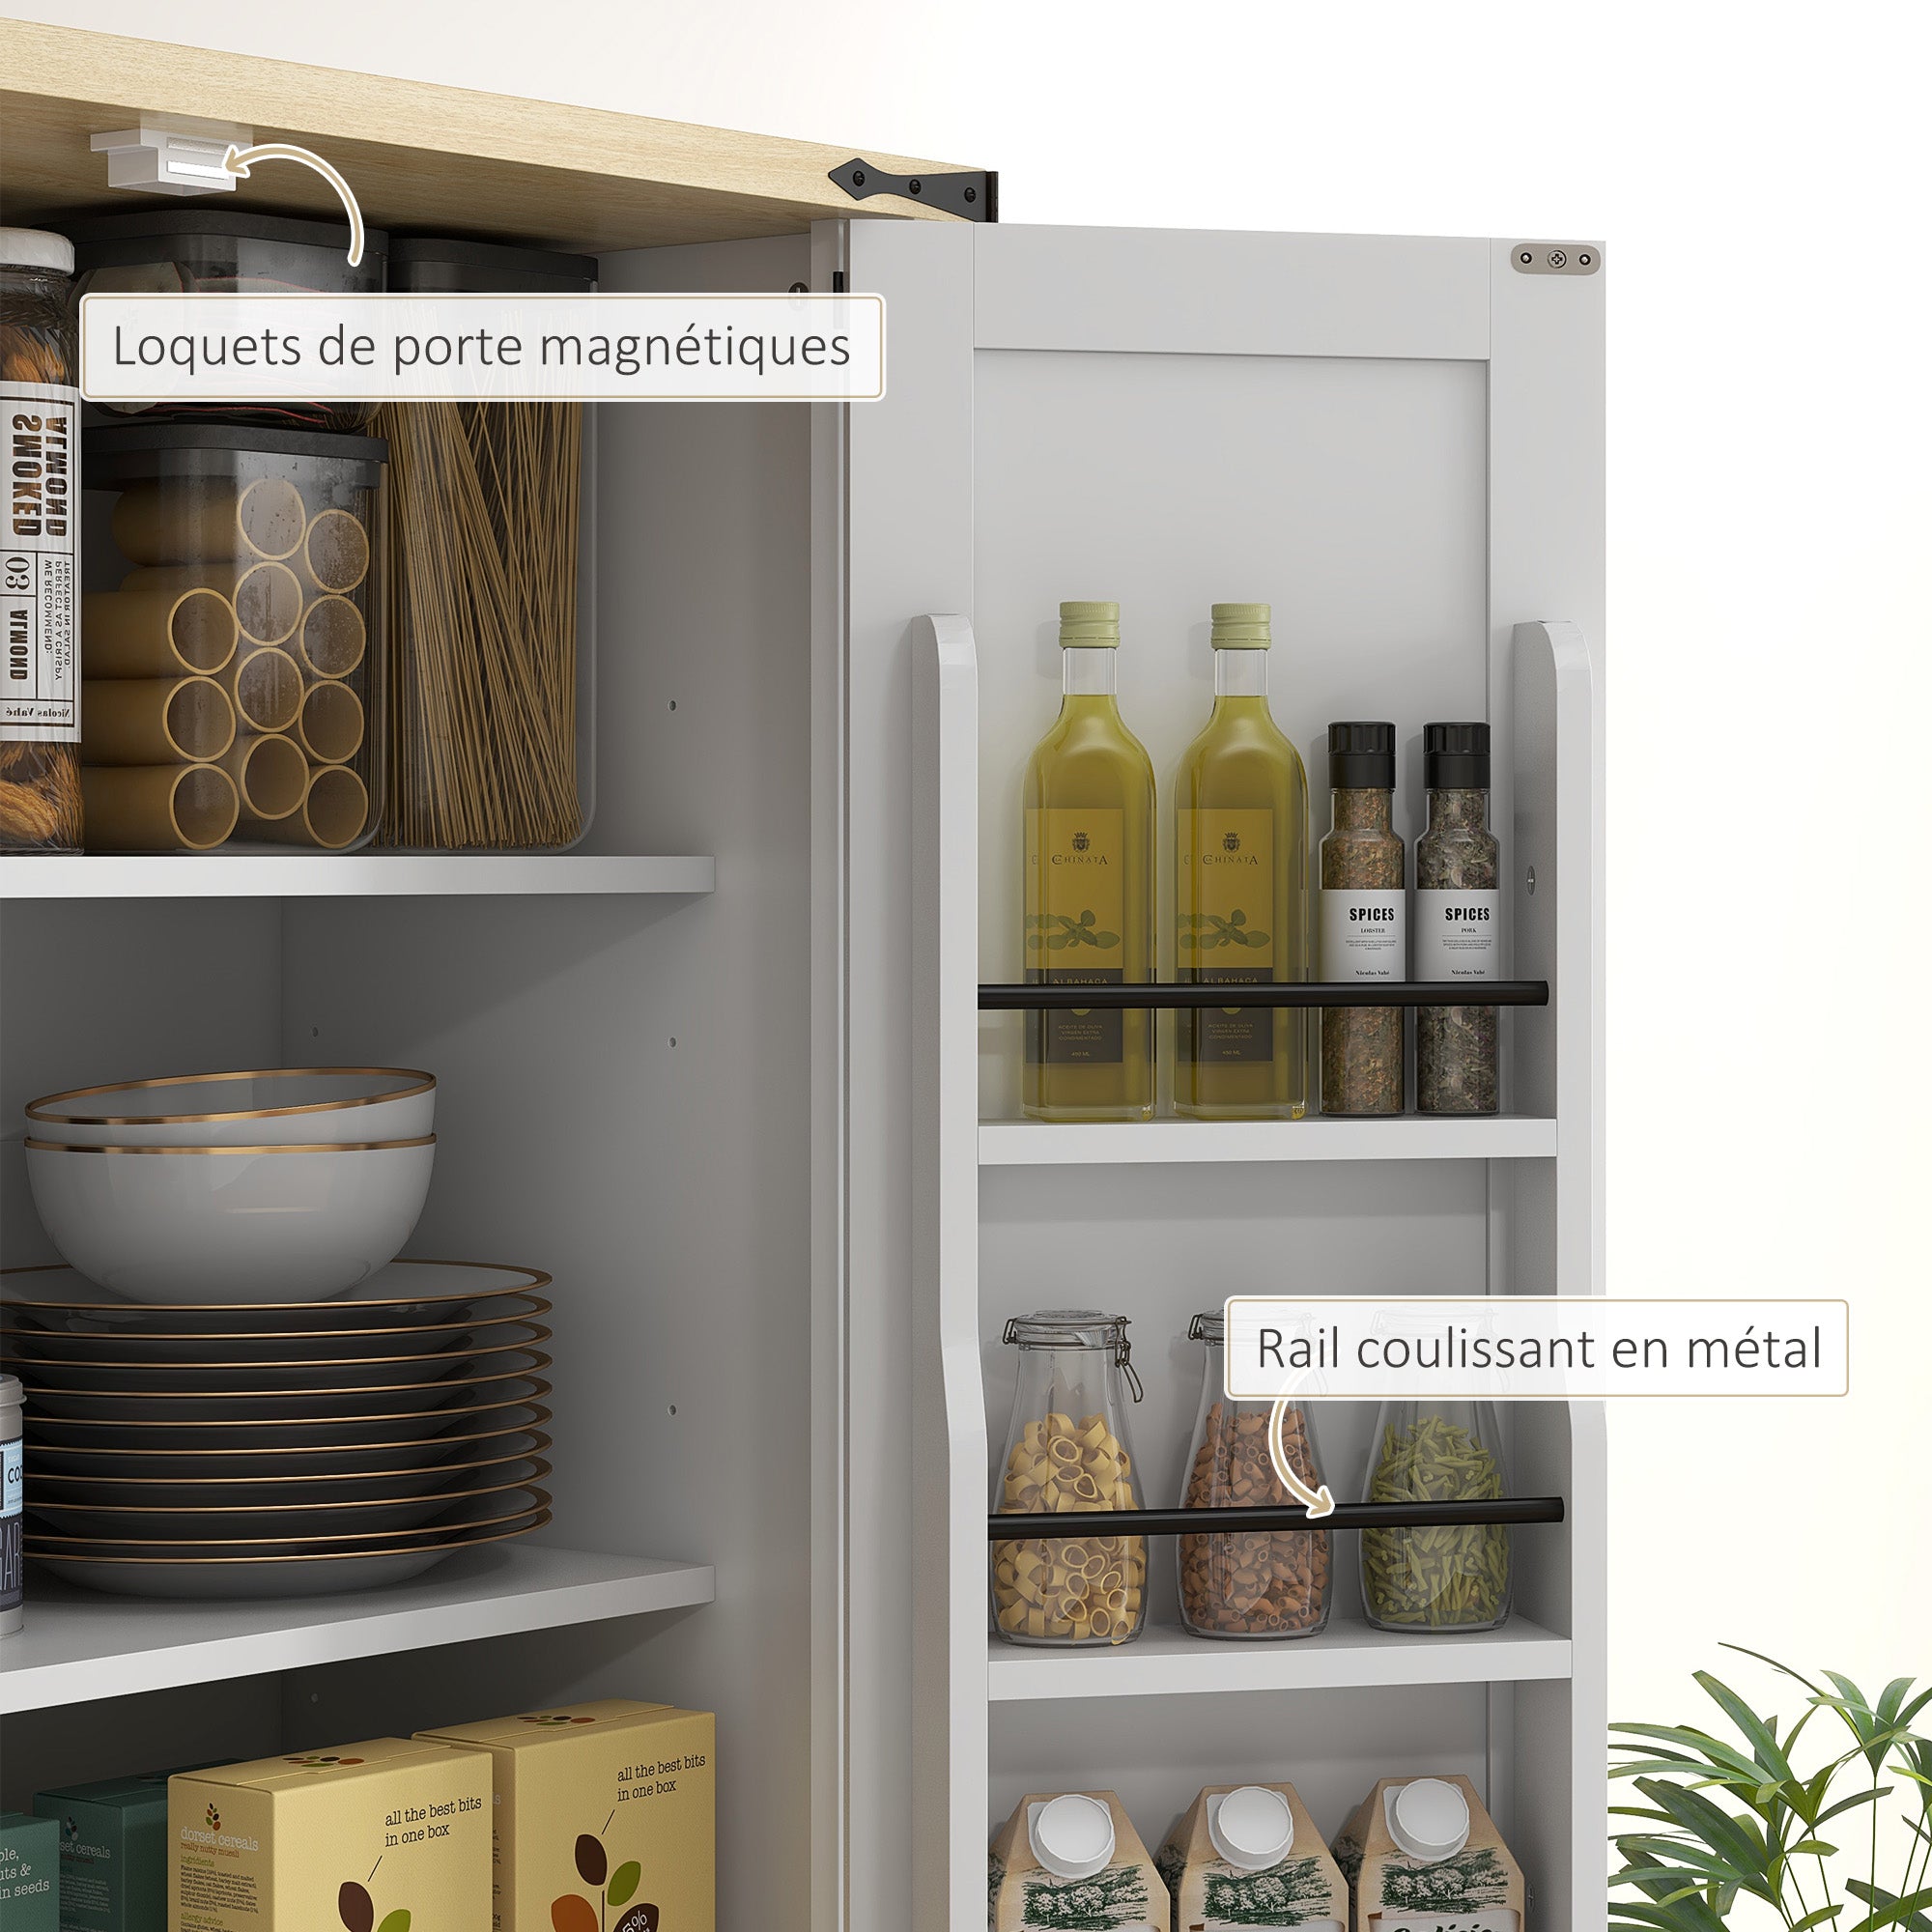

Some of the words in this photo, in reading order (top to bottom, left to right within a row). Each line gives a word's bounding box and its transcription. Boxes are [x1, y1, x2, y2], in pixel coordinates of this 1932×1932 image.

[1350, 908, 1395, 921] SPICES
[1445, 907, 1491, 921] SPICES
[617, 1766, 633, 1782] all
[636, 1764, 655, 1778] the
[657, 1758, 682, 1775] best
[684, 1754, 706, 1769] bits
[617, 1787, 630, 1802] in
[633, 1785, 654, 1799] one
[656, 1780, 677, 1794] box
[385, 1810, 402, 1827] all
[405, 1808, 426, 1823] the
[429, 1801, 456, 1818] best
[459, 1797, 482, 1812] bits
[181, 1826, 216, 1844] dorset
[218, 1834, 259, 1852] cereals
[385, 1833, 398, 1847] in
[402, 1830, 425, 1843] one
[427, 1825, 450, 1838] box
[76, 1843, 111, 1859] cereals
[20, 1862, 32, 1877] &
[14, 1879, 49, 1896] seeds
